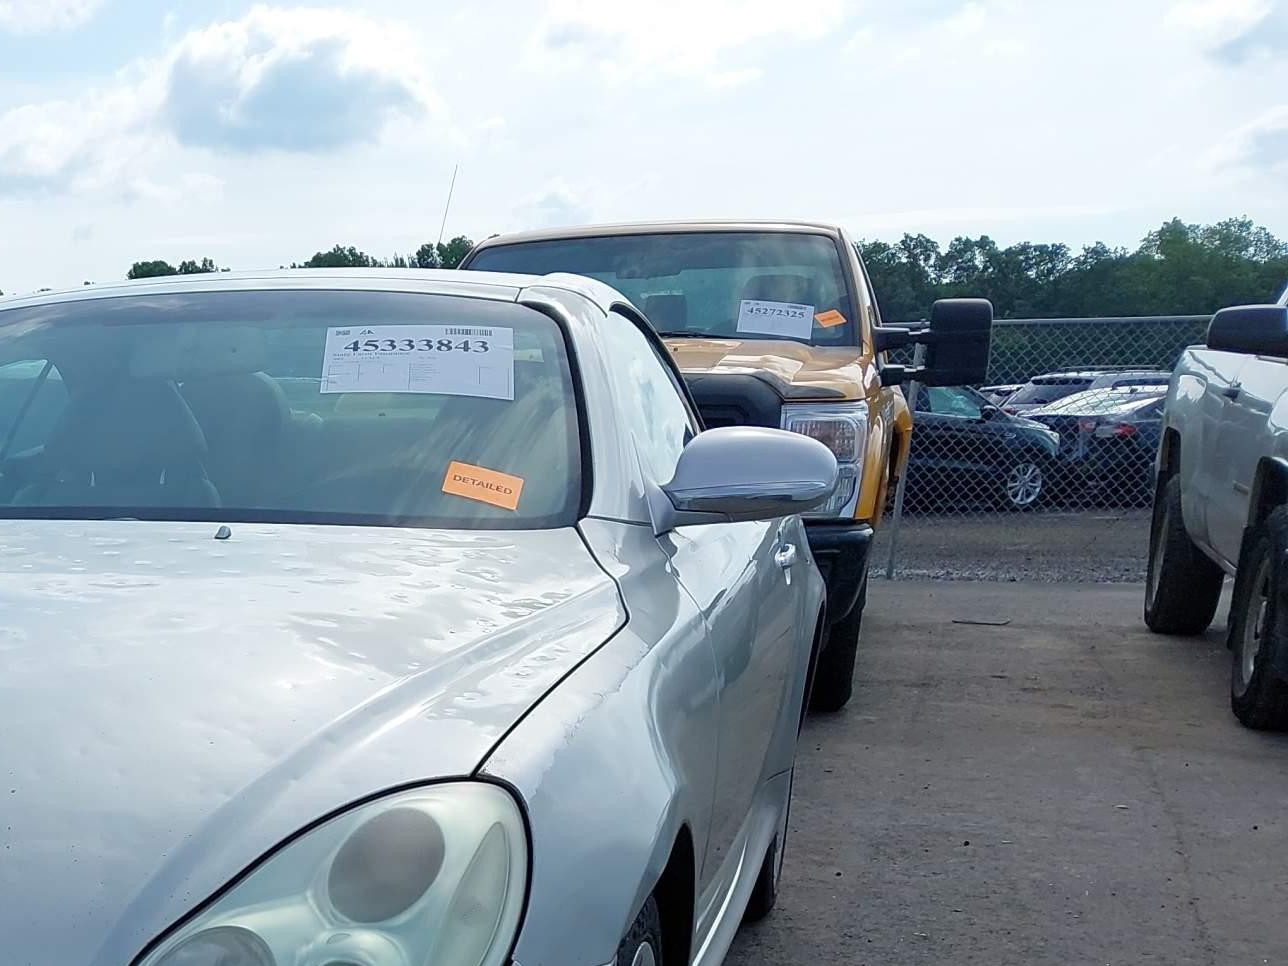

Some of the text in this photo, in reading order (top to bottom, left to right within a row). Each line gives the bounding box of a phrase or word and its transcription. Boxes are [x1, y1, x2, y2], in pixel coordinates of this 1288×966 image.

[747, 306, 805, 319] 45272325
[344, 338, 490, 353] 45333843
[453, 474, 513, 495] DETAILED
